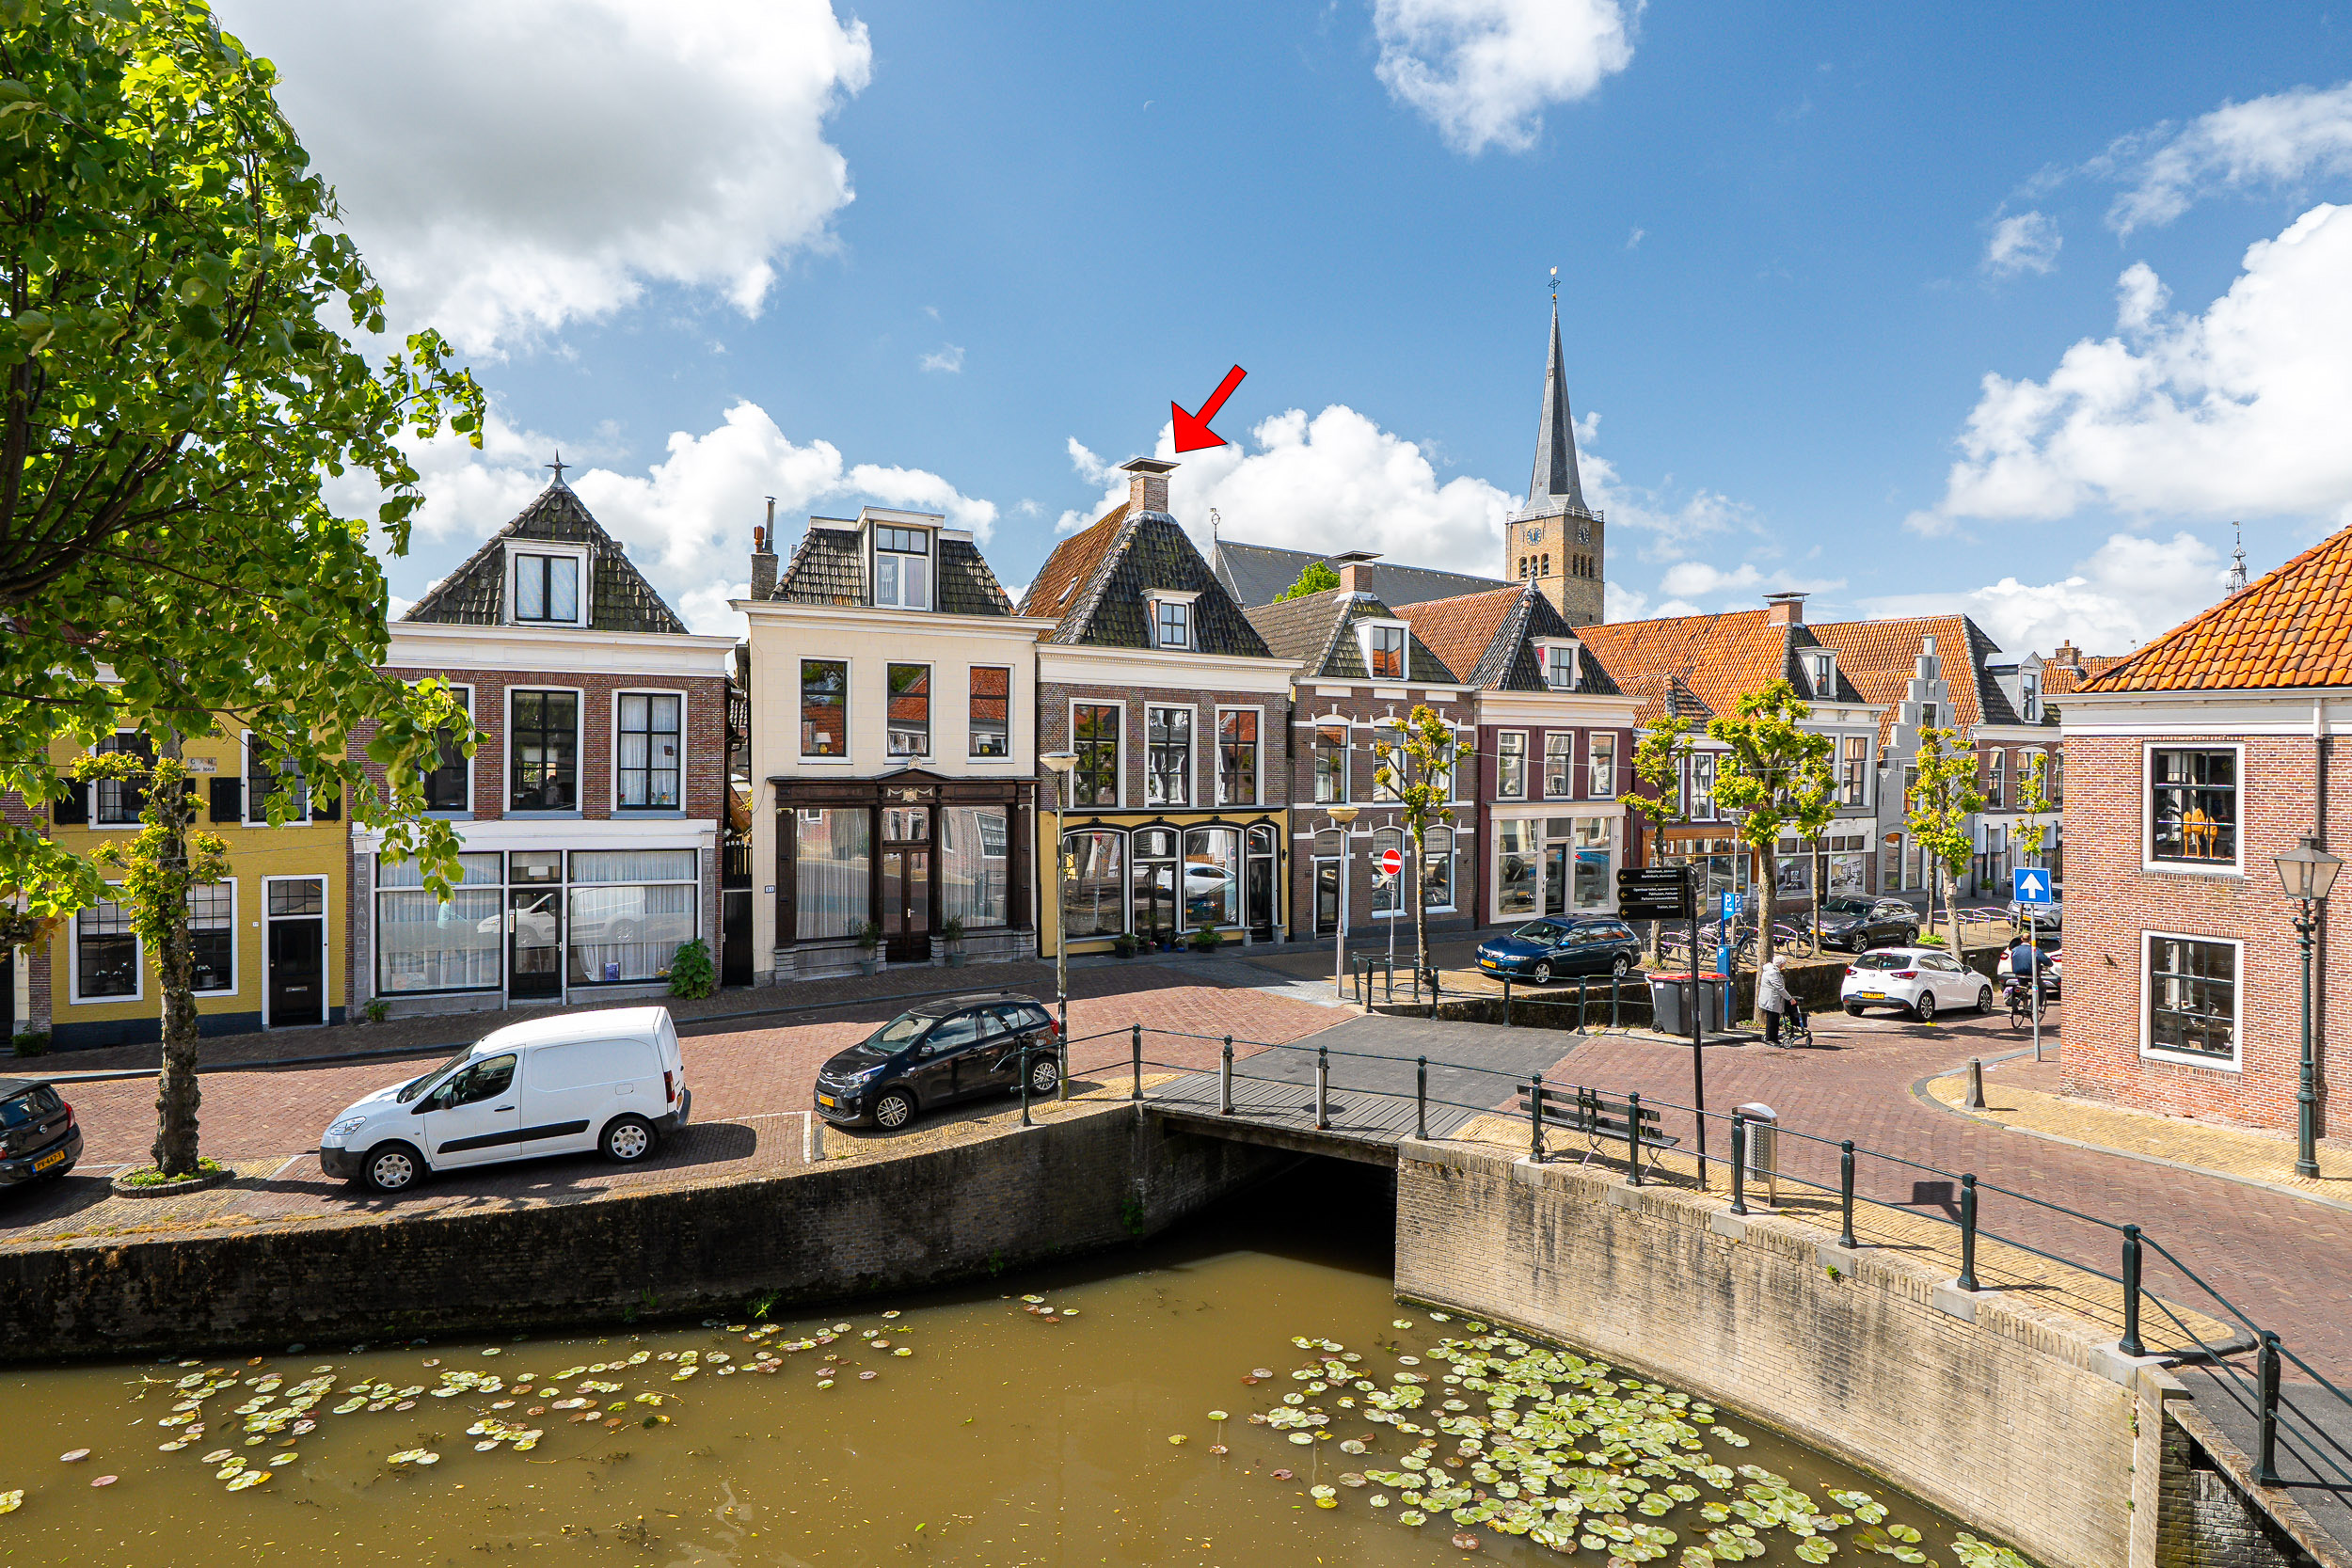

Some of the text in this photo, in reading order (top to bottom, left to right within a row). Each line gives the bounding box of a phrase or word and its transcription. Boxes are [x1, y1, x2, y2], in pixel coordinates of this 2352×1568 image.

[1724, 894, 1732, 907] P
[1734, 895, 1740, 908] P
[1718, 947, 1724, 957] P
